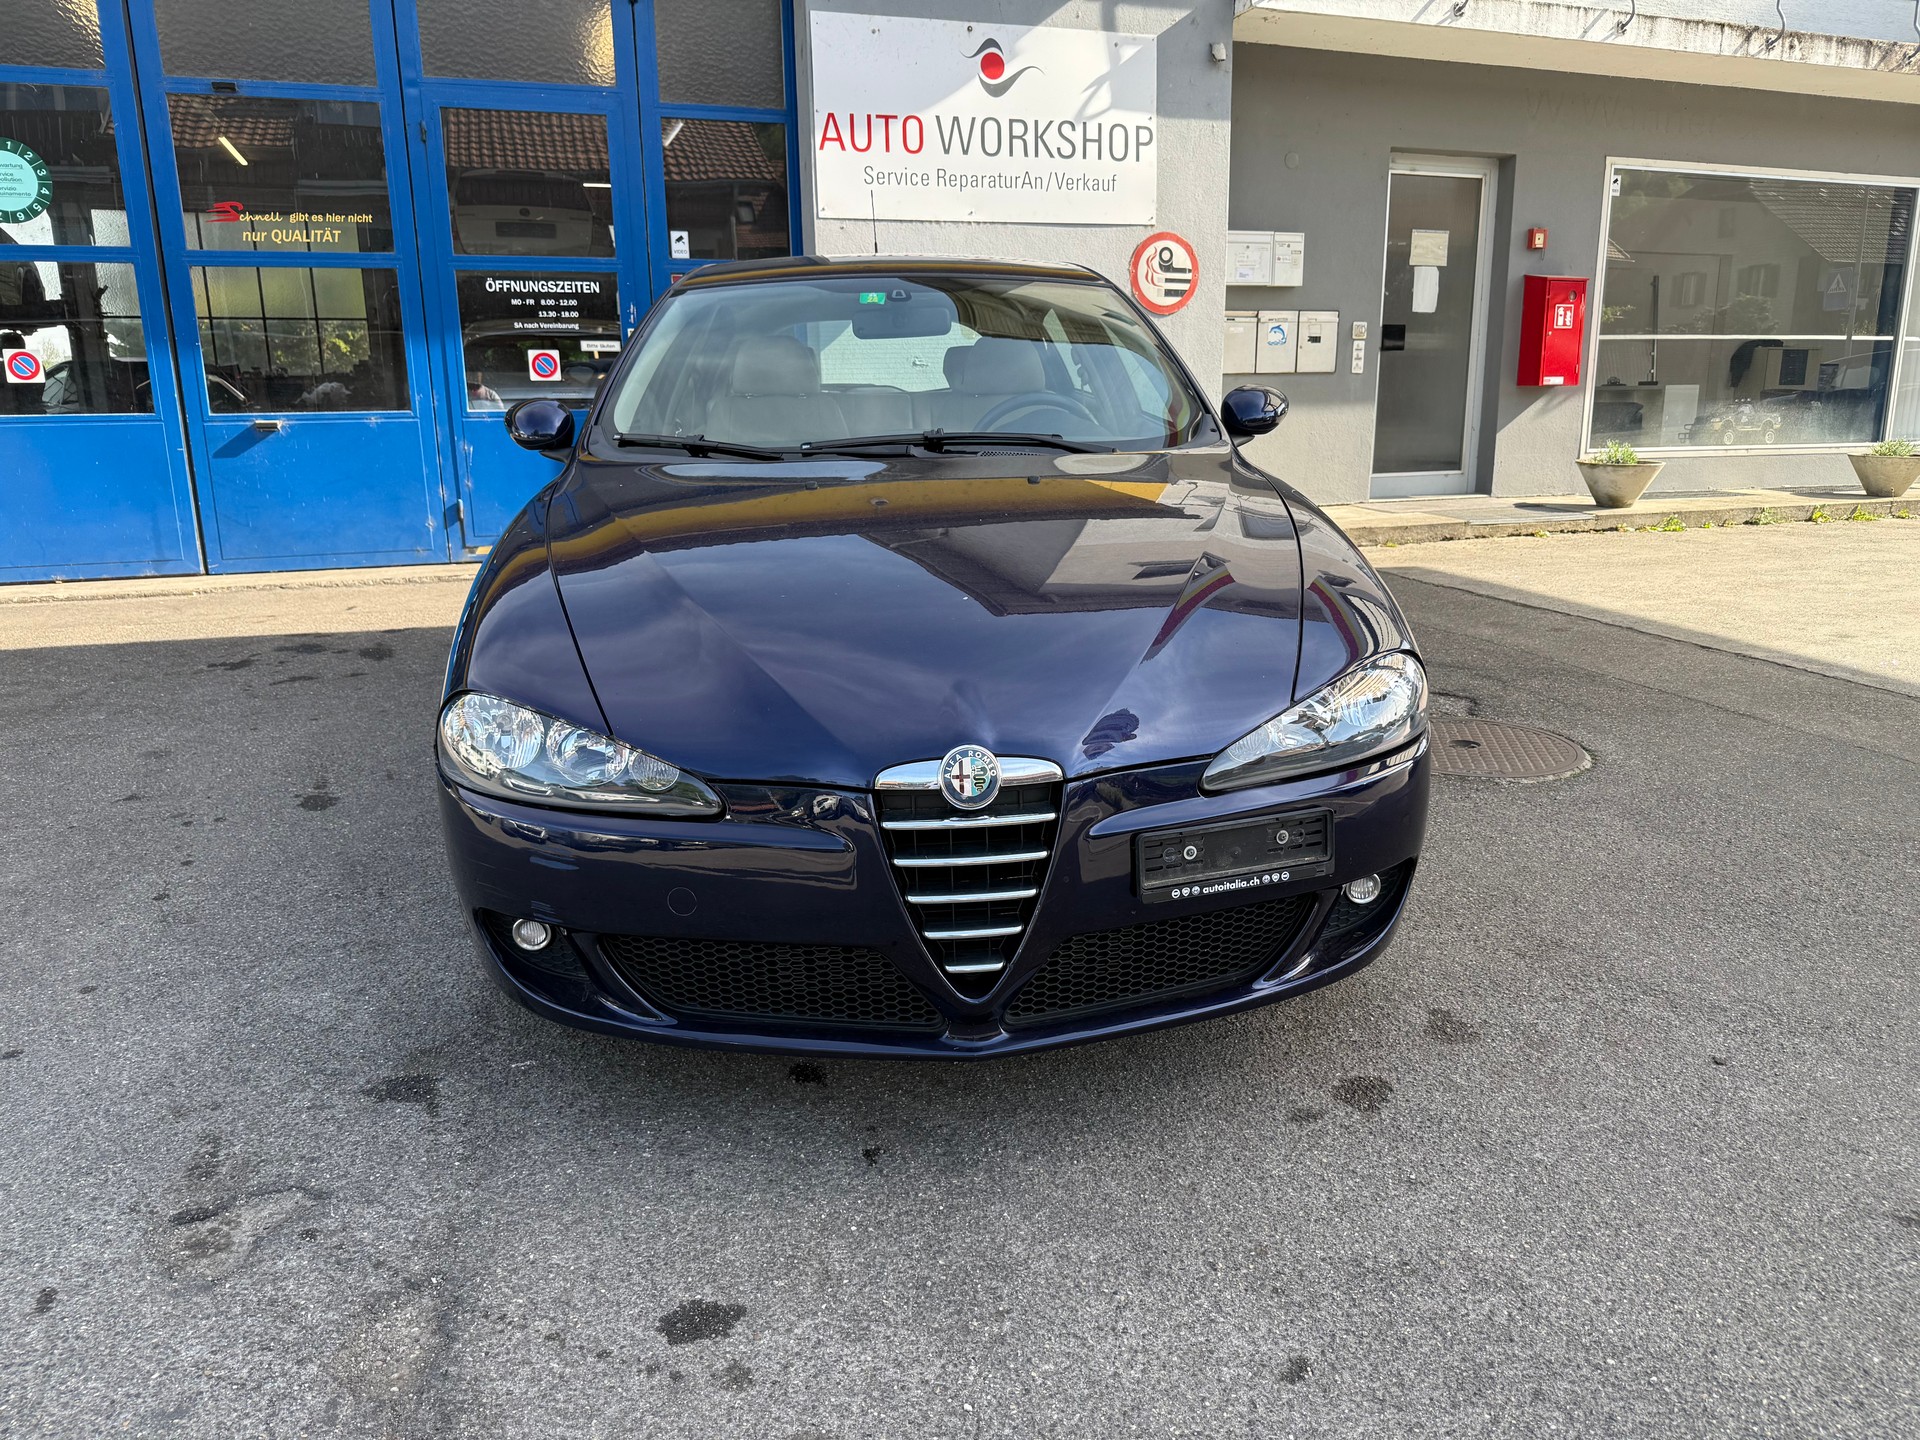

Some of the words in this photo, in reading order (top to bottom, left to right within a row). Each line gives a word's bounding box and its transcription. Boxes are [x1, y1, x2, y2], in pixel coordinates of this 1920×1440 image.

[819, 112, 924, 155] AUTO
[935, 115, 1154, 162] WORKSHOP
[24, 152, 33, 160] 2
[864, 166, 930, 187] Service
[40, 187, 50, 195] 4
[33, 203, 43, 211] 5
[207, 201, 283, 223] Schnell
[289, 212, 309, 223] gibt
[311, 214, 323, 223] es
[326, 213, 345, 223] hier
[348, 213, 373, 223] nicht
[16, 212, 25, 220] 6
[242, 231, 267, 242] nur
[271, 227, 341, 244] QUALITÄT
[485, 277, 600, 294] ÖFFNUNGSZEITEN
[540, 322, 579, 330] Vereinbarung
[944, 753, 963, 779] ALFA
[968, 750, 997, 776] ROMEO
[1202, 876, 1260, 894] autoitalia.ch
